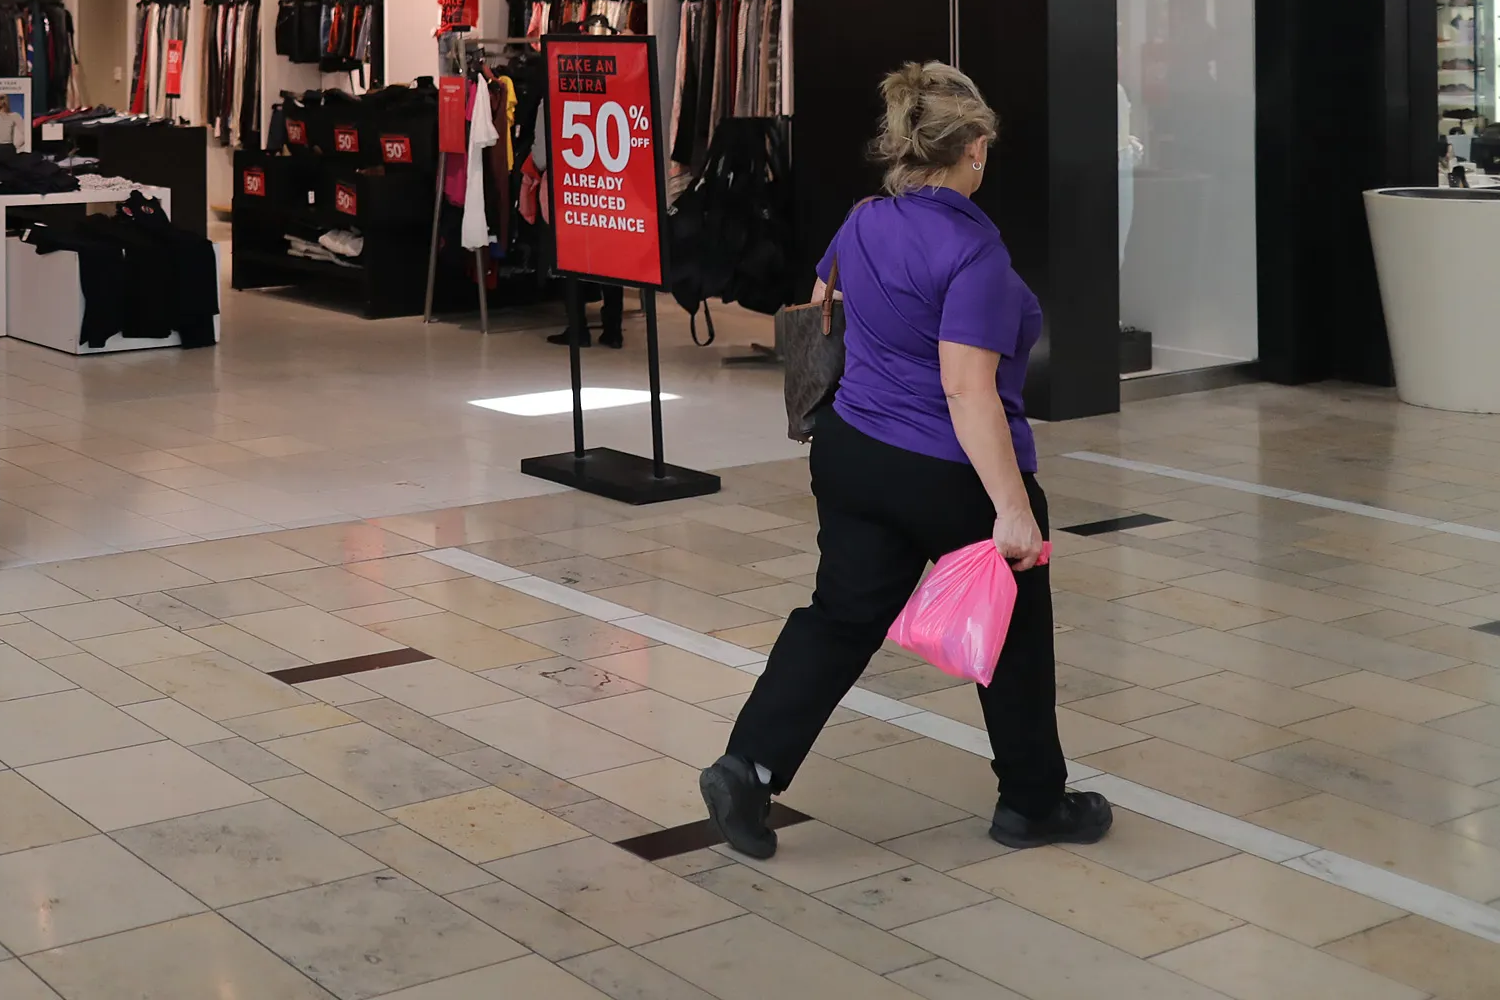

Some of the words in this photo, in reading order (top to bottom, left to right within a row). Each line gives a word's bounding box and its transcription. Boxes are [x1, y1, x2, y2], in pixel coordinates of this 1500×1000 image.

[560, 58, 592, 72] TAKE
[595, 59, 614, 73] AN
[560, 77, 603, 92] EXTRA
[630, 137, 650, 149] OFF
[563, 172, 624, 191] ALREADY
[563, 191, 626, 211] REDUCED
[564, 210, 646, 233] CLEARANCE
